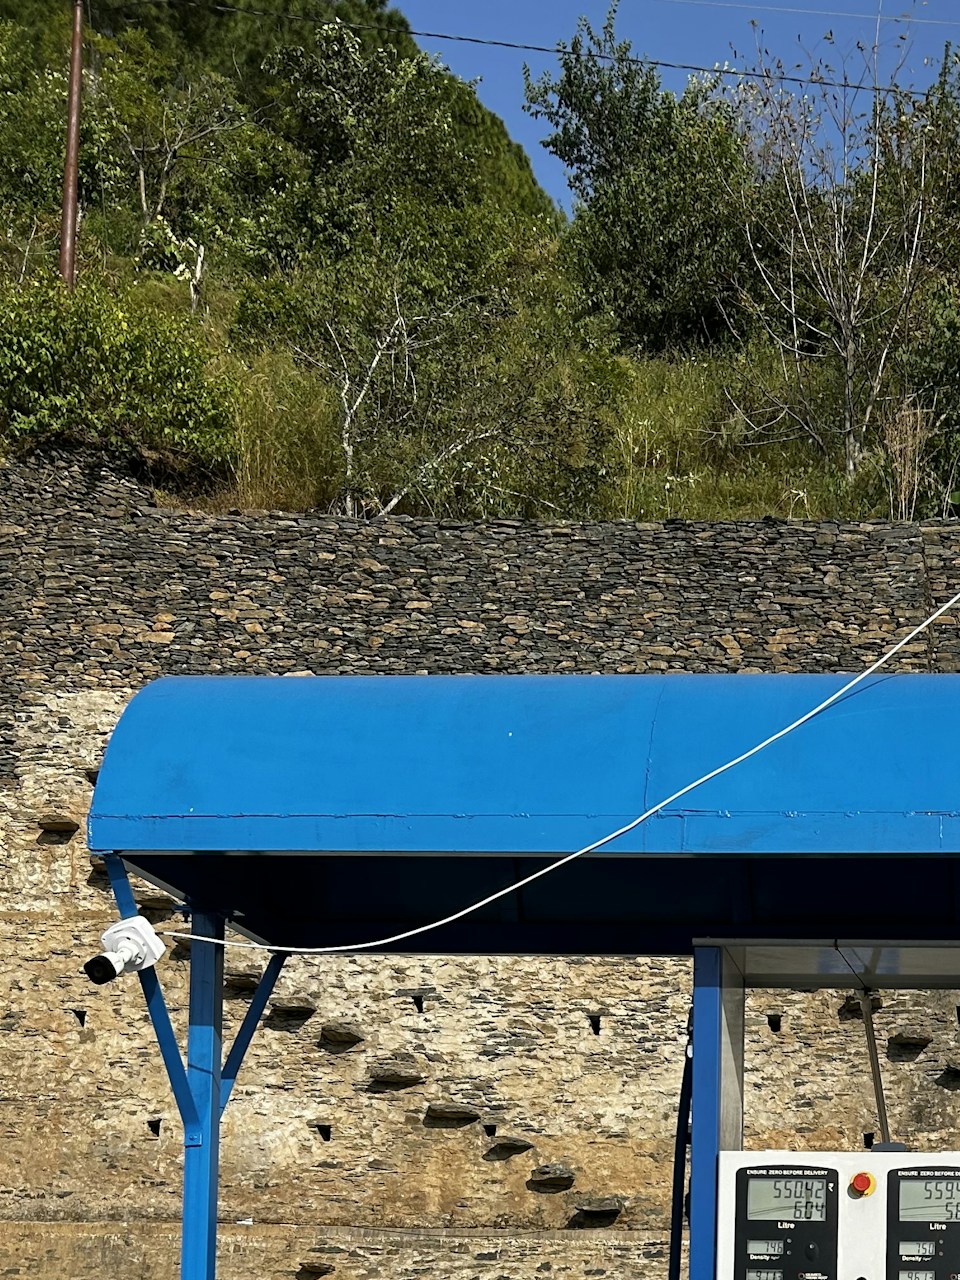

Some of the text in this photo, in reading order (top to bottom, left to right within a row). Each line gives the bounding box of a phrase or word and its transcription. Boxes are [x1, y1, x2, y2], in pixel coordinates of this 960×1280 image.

[774, 1181, 824, 1198] 550.42
[765, 1242, 783, 1253] 746
[916, 1243, 934, 1254] 750
